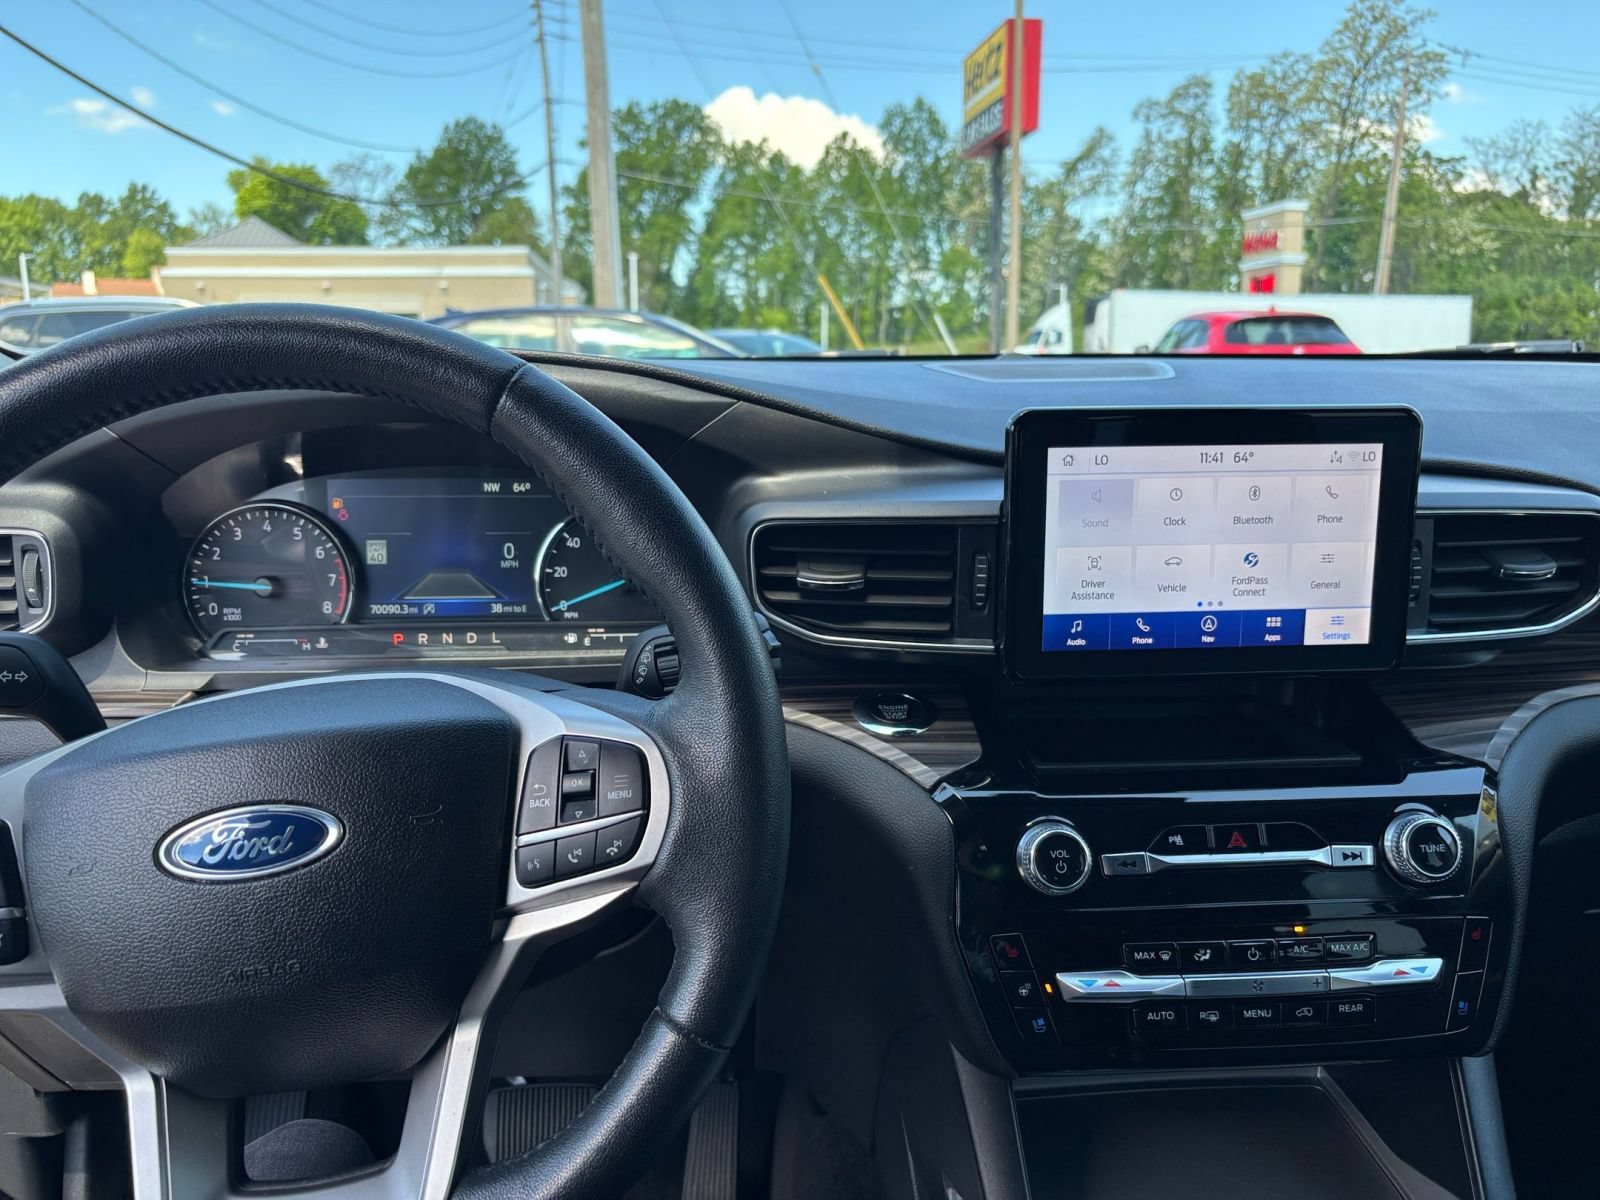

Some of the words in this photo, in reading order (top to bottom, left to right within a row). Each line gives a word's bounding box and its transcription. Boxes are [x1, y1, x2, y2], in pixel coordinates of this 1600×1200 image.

[1095, 454, 1109, 466] LO
[1200, 452, 1224, 464] 11:41
[1362, 450, 1376, 462] LO
[484, 483, 501, 492] NW
[1082, 519, 1109, 528] Sound
[1163, 517, 1186, 526] Clock
[1233, 515, 1273, 525] Bluetooth
[1317, 514, 1343, 524] Phone
[262, 520, 272, 532] 4
[234, 528, 242, 540] 3
[293, 527, 302, 540] 5
[566, 537, 580, 548] 40
[212, 548, 221, 560] 2
[316, 546, 325, 559] 6
[504, 543, 515, 559] 0
[501, 561, 519, 569] MPH
[554, 566, 567, 577] 20
[328, 574, 337, 587] 7
[1081, 579, 1105, 588] Driver
[1232, 576, 1268, 586] FordPass
[1310, 580, 1341, 590] General
[1157, 583, 1187, 593] Vehicle
[1232, 588, 1266, 597] Connect
[1071, 591, 1115, 601] Assistance
[208, 602, 218, 615] 0
[322, 601, 332, 614] 8
[491, 604, 502, 613] 38
[503, 605, 513, 613] mi
[393, 633, 404, 645] P
[418, 633, 428, 644] R
[442, 633, 453, 644] N
[467, 632, 478, 644] D
[492, 632, 501, 643] L
[584, 637, 591, 646] E
[1132, 637, 1153, 645] Phone
[1201, 635, 1215, 643] Nav
[1264, 633, 1281, 642] Apps
[1321, 632, 1350, 641] Settings
[1066, 638, 1086, 646] Audio
[571, 778, 583, 787] OK
[607, 789, 632, 800] MENU
[529, 798, 551, 808] BACK
[203, 819, 295, 864] Ford
[1419, 843, 1446, 853] TUNE
[1050, 850, 1070, 858] VOL
[1293, 945, 1309, 953] A/C
[1331, 943, 1352, 952] MAX
[1353, 942, 1369, 951] A/C
[1134, 951, 1156, 960] MAX
[1243, 1009, 1272, 1018] MENU
[1338, 1004, 1363, 1013] REAR
[1147, 1011, 1175, 1020] AUTO
